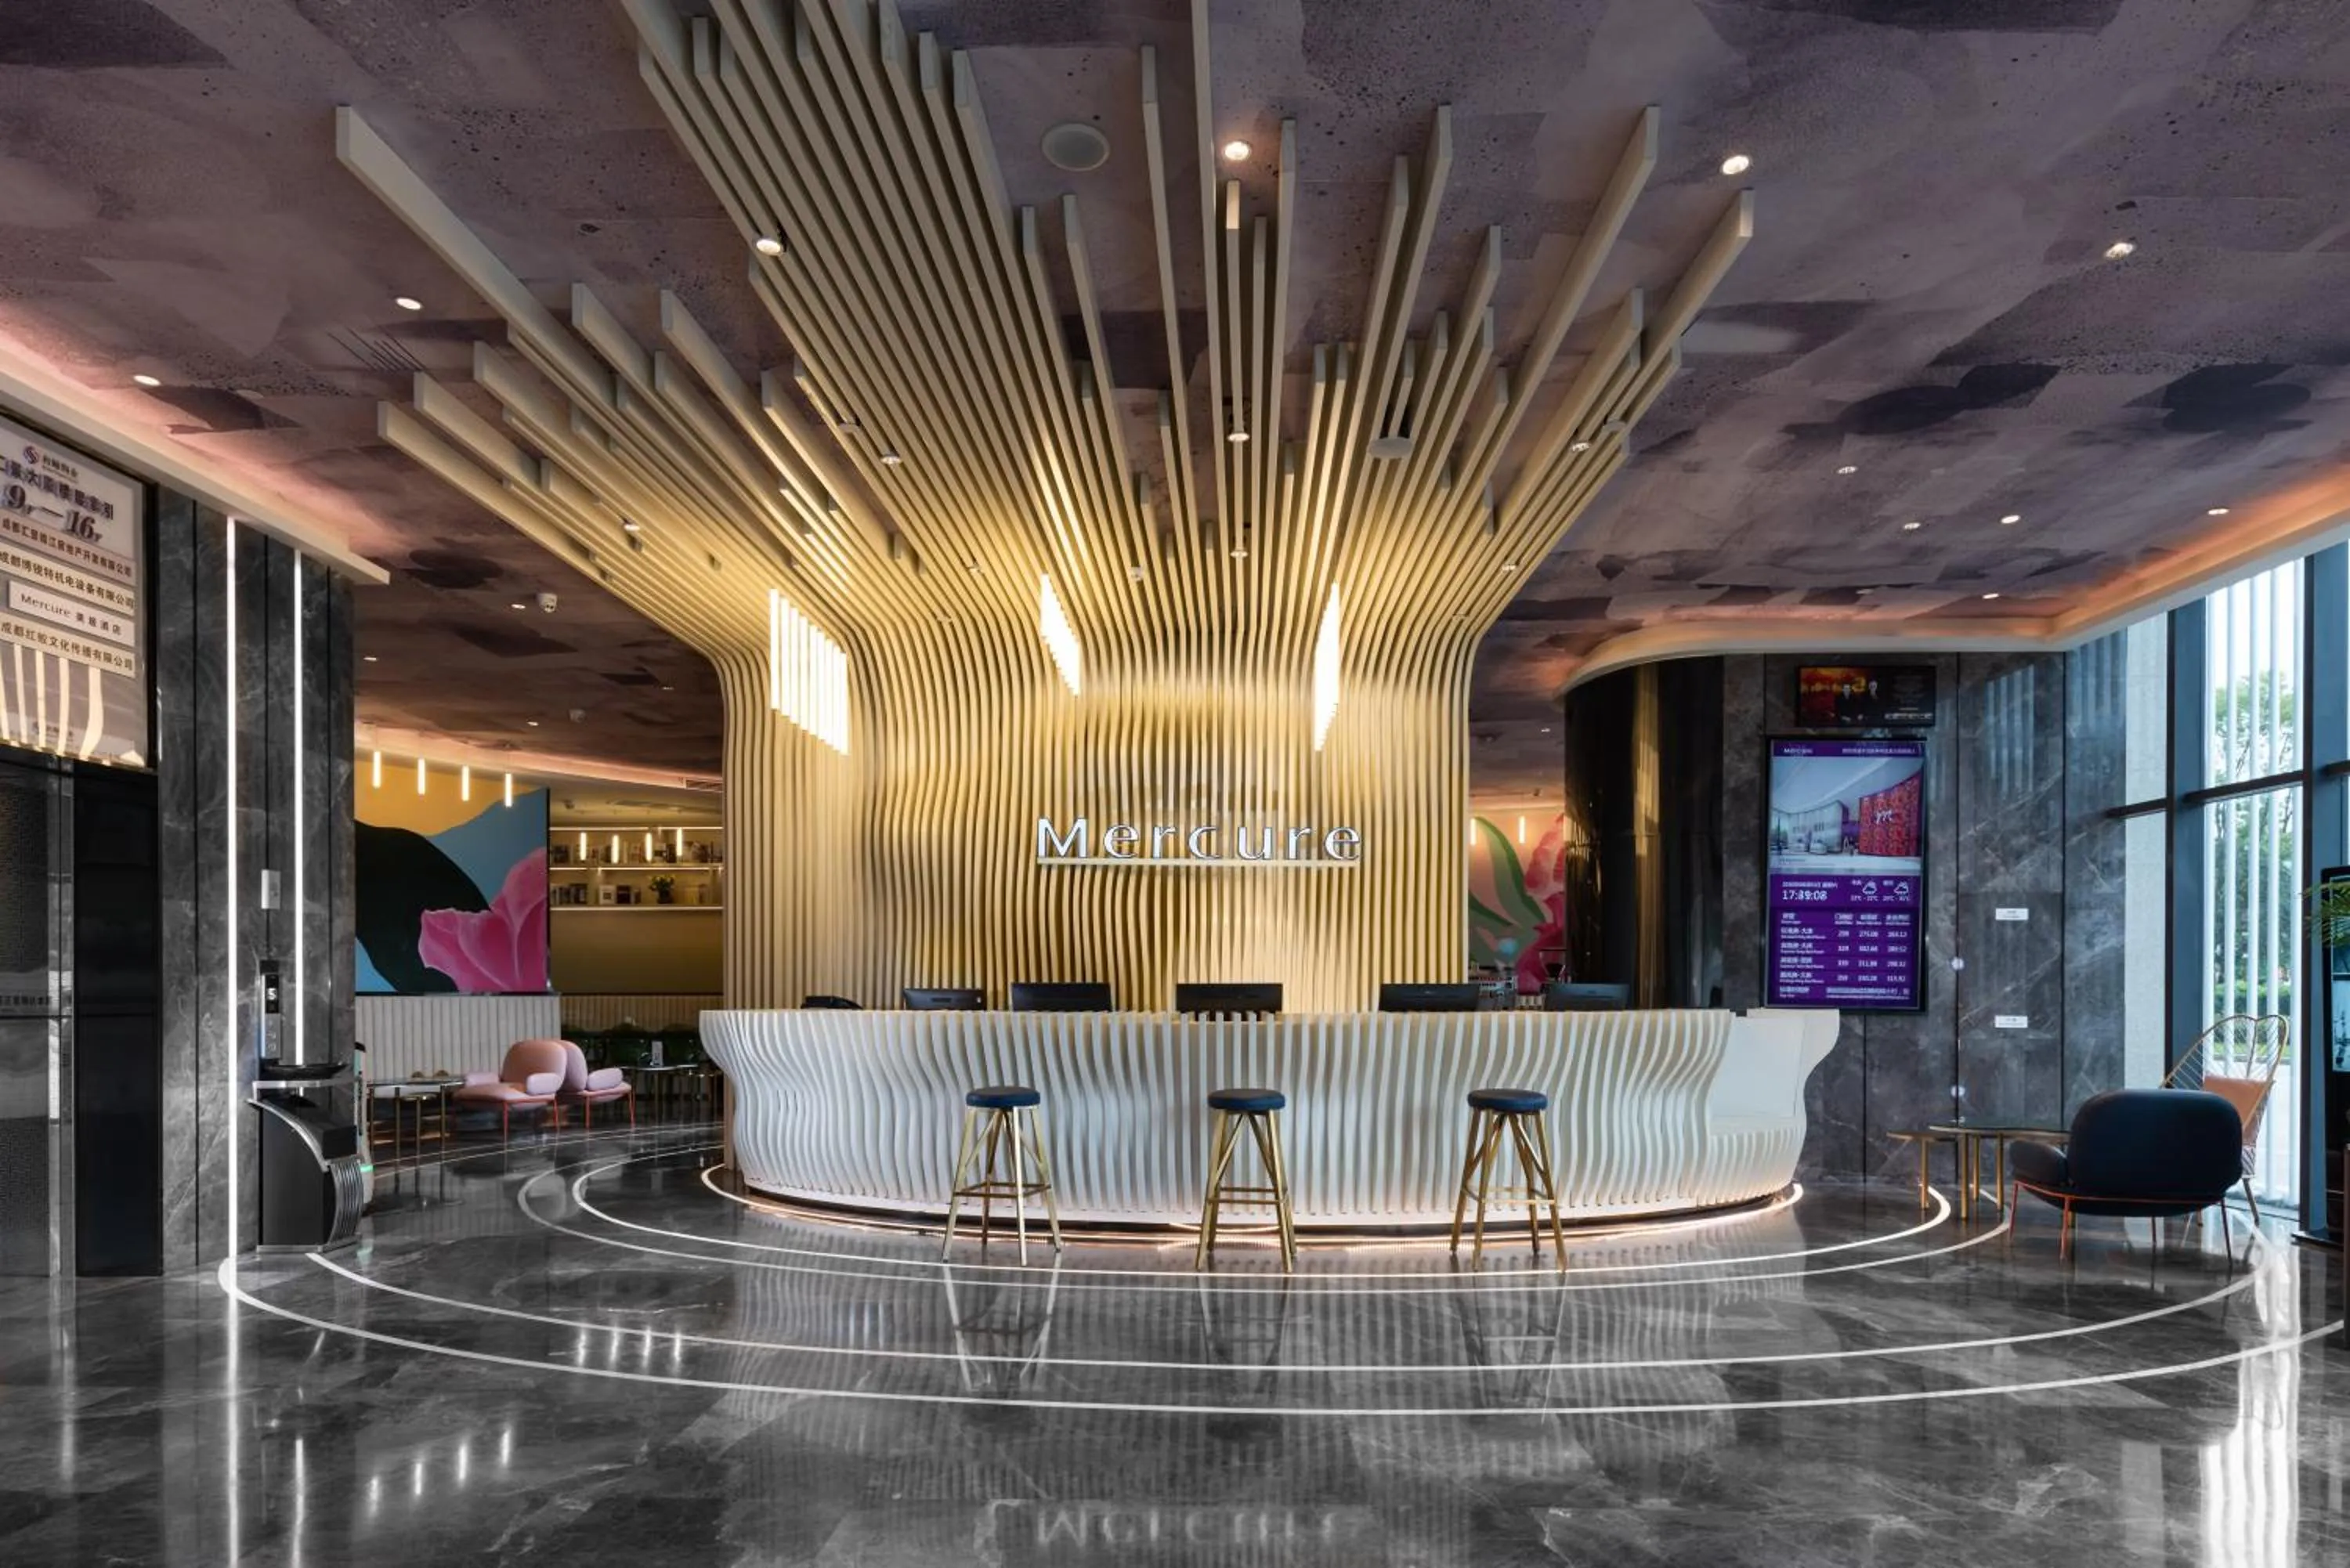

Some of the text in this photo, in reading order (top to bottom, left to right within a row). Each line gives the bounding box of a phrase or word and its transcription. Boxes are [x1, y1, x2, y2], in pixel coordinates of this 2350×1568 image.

[20, 594, 70, 617] Mercure
[1037, 817, 1360, 860] Mercure
[267, 987, 277, 1000] 5
